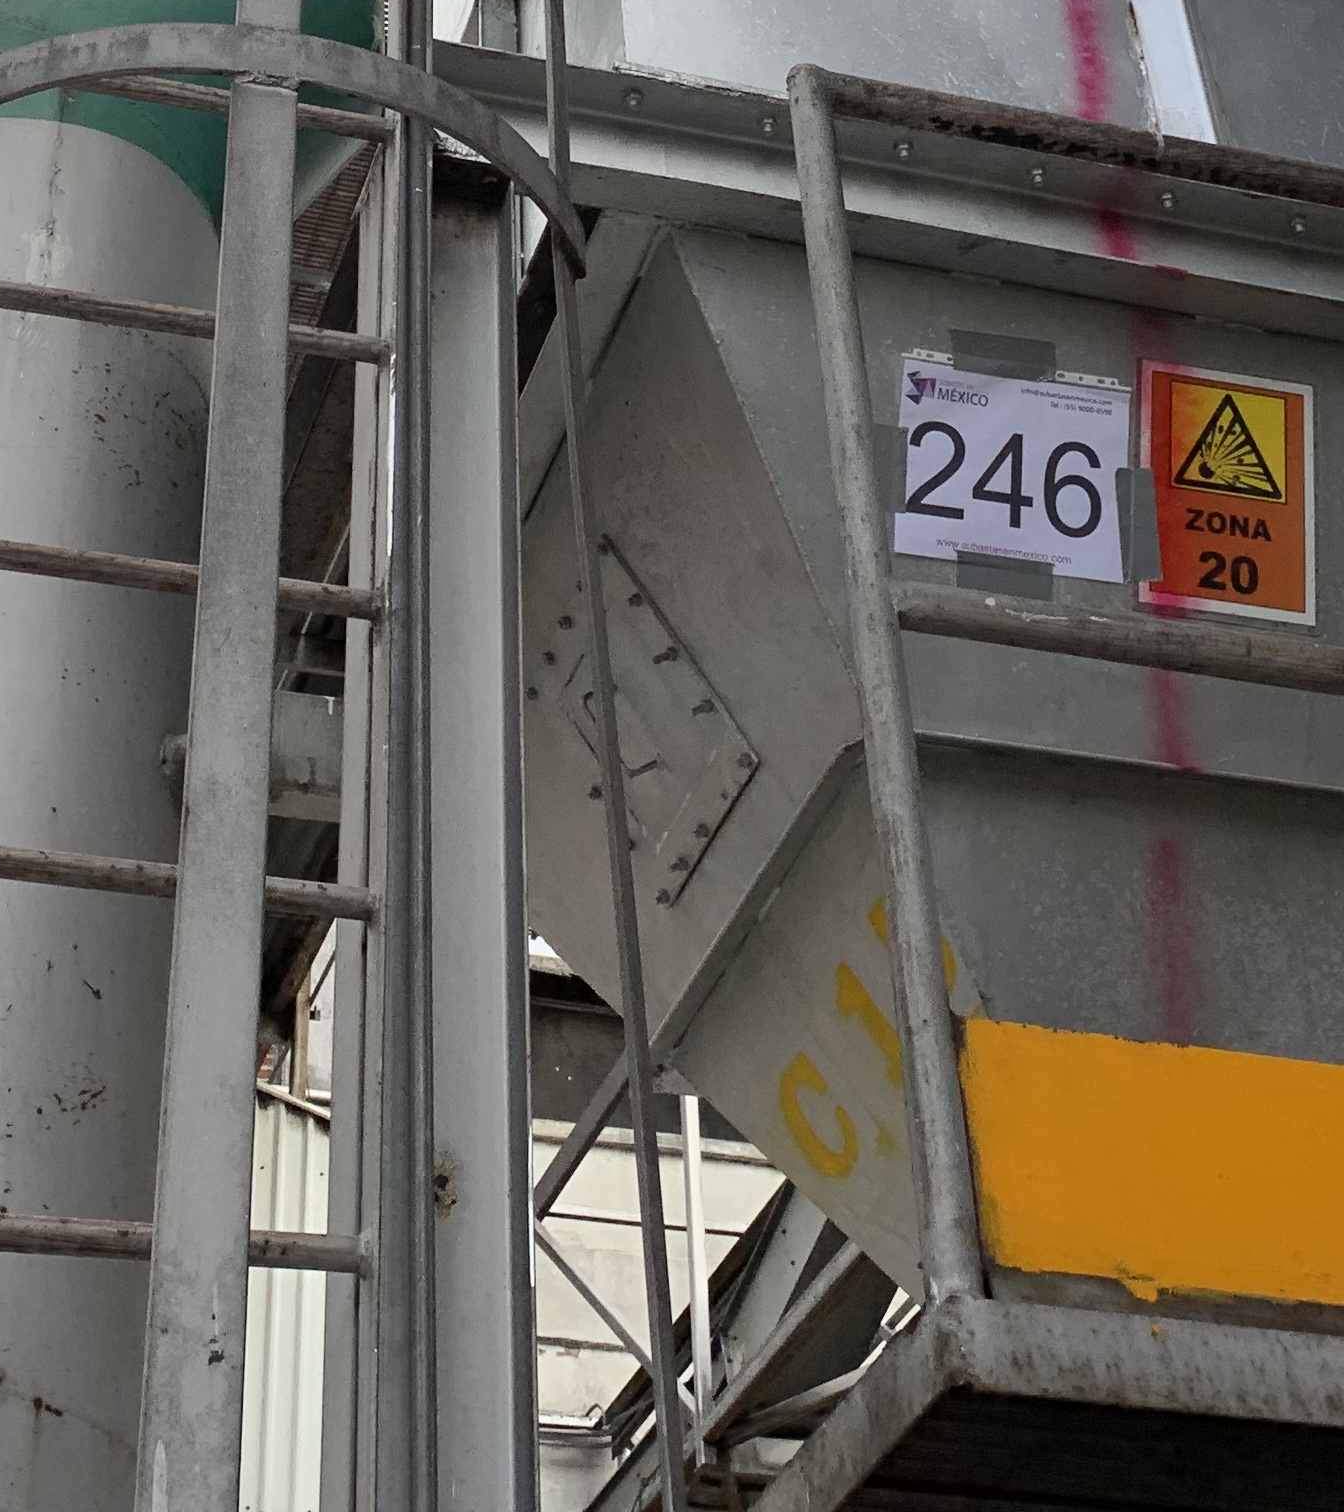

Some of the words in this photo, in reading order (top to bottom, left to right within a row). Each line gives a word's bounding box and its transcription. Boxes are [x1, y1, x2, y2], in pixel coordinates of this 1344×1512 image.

[936, 386, 989, 407] MÉXICO
[905, 420, 1103, 539] 246
[1185, 508, 1272, 543] ZONA
[1198, 550, 1259, 596] 20
